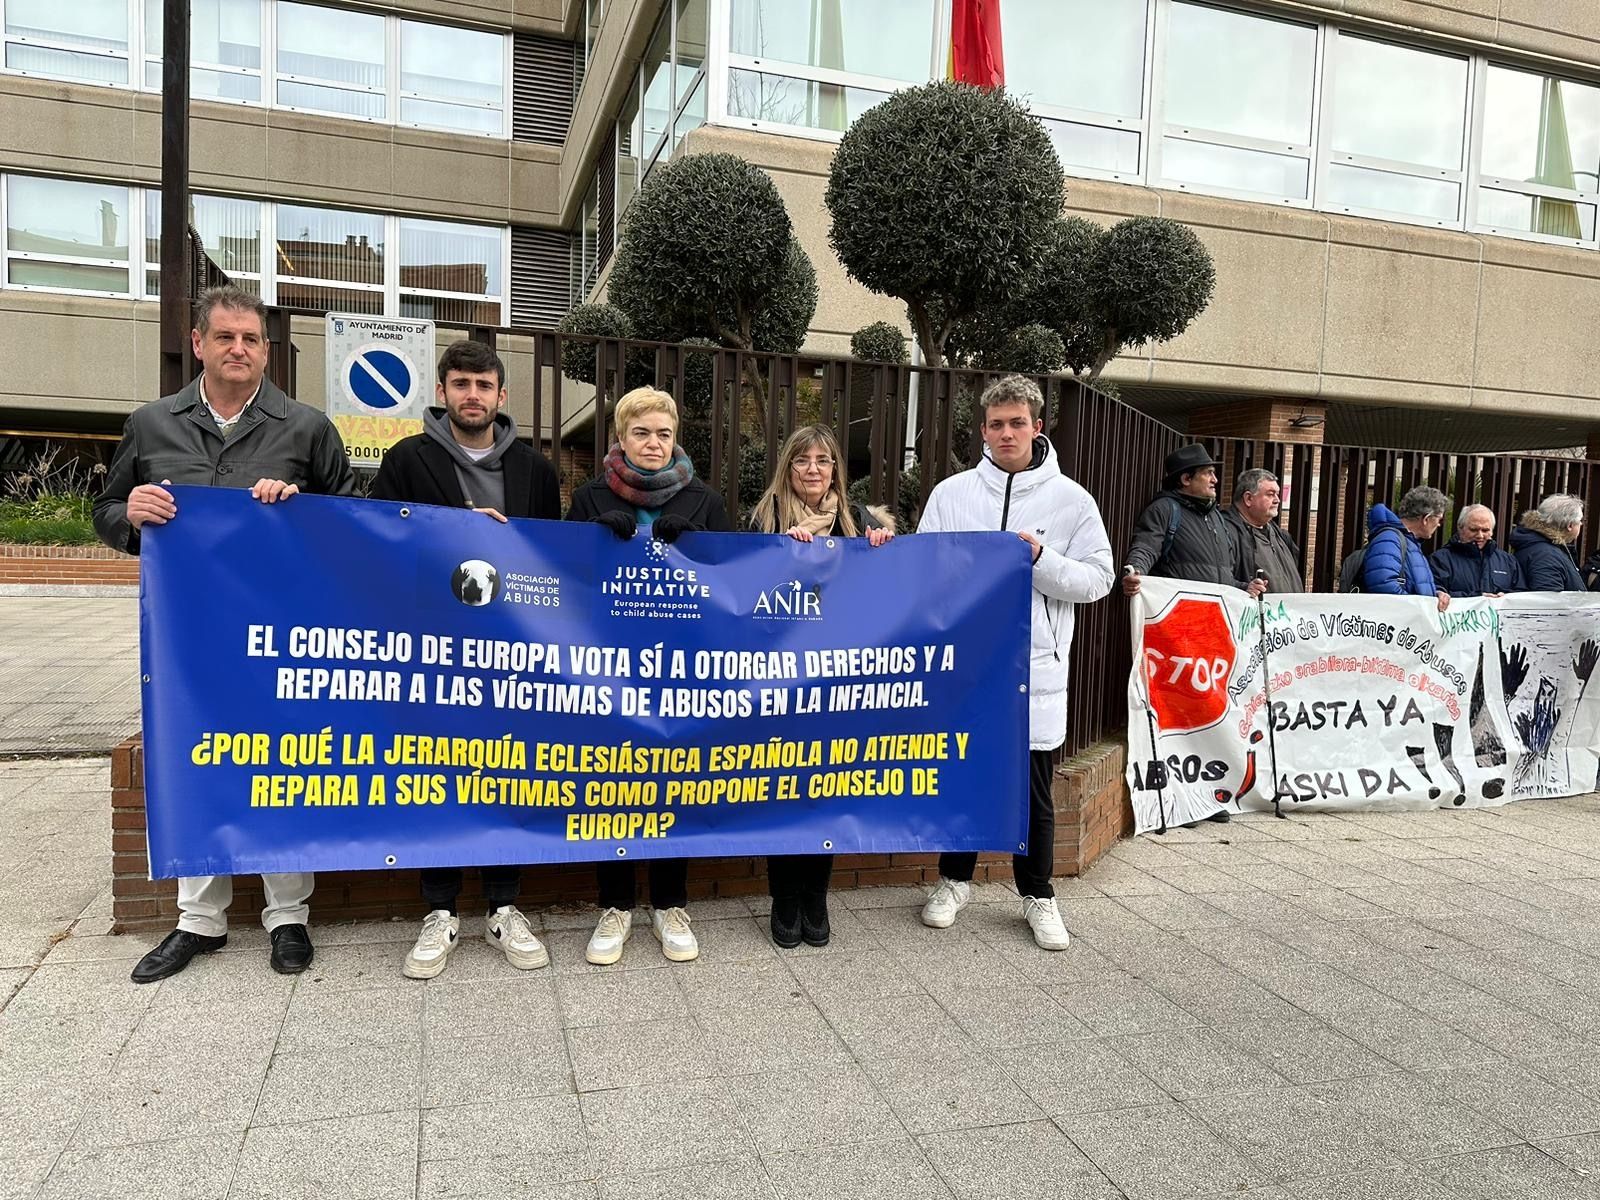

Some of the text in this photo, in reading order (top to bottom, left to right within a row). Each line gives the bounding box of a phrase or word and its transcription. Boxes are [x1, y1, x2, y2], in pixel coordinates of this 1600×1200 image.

[349, 321, 413, 333] AYUNTAMIENTO
[372, 332, 403, 341] MADRID
[339, 416, 421, 439] VADO
[505, 572, 560, 585] ASOCIACIÓN
[615, 566, 697, 582] JUSTICE
[505, 581, 560, 595] VÍCTIMAS DE
[602, 581, 711, 598] INITIATIVE
[503, 591, 560, 607] ABUSOS
[614, 600, 699, 610] European response
[610, 609, 621, 617] to
[248, 625, 953, 679] EL CONSEJO DE EUROPA VOTA SÍ A OTORGAR DERECHOS Y A
[1297, 617, 1319, 640] de
[1396, 627, 1418, 650] de
[1414, 639, 1468, 696] Abusos
[277, 668, 928, 717] REPARAR A LAS VÍCTIMAS DE ABUSOS EN LA INFANCIA.
[1270, 694, 1425, 732] BASTA YA
[191, 728, 968, 773] ¿POR QUÉ LA JERARQUÍA ECLESIÁSTICA ESPAÑOLA NO ATIENDE Y
[251, 768, 938, 806] REPARA A SUS VÍCTIMAS COMO PROPONE EL CONSEJO DE
[1271, 771, 1349, 803] ASKI
[567, 813, 674, 840] EUROPA?
